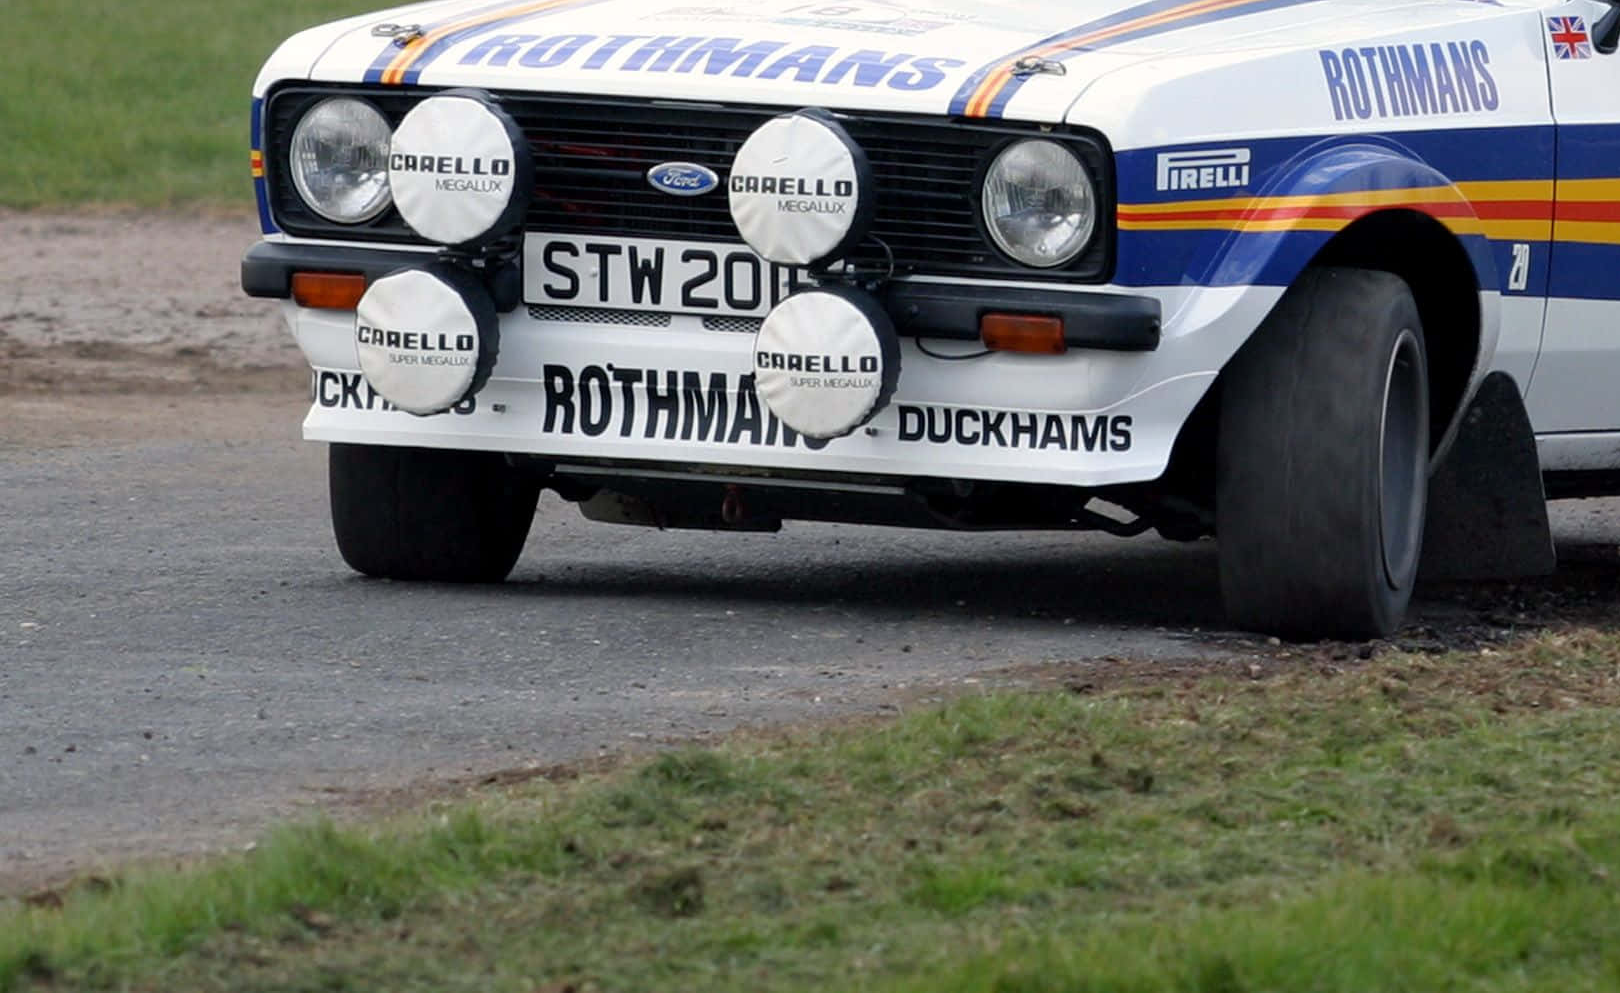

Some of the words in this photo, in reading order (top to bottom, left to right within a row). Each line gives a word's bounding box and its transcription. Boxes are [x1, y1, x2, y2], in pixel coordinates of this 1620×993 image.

[457, 34, 966, 91] ROTHMANS
[1320, 40, 1499, 121] ROTHMANS
[390, 153, 510, 176] CARELLO
[1157, 148, 1250, 191] PIRELLI
[435, 179, 502, 192] MEGALUX
[662, 168, 701, 189] Ford
[731, 176, 854, 197] CARELLO
[777, 200, 846, 214] MEGALUX
[543, 240, 665, 305] STW
[358, 325, 474, 351] CARELLO
[388, 353, 420, 364] SUPER
[421, 354, 470, 366] MEGALUX
[757, 351, 878, 373] CARELLO
[790, 377, 820, 387] SUPER
[823, 378, 873, 389] MEGALUX
[897, 405, 1133, 452] DUCKHAMS
